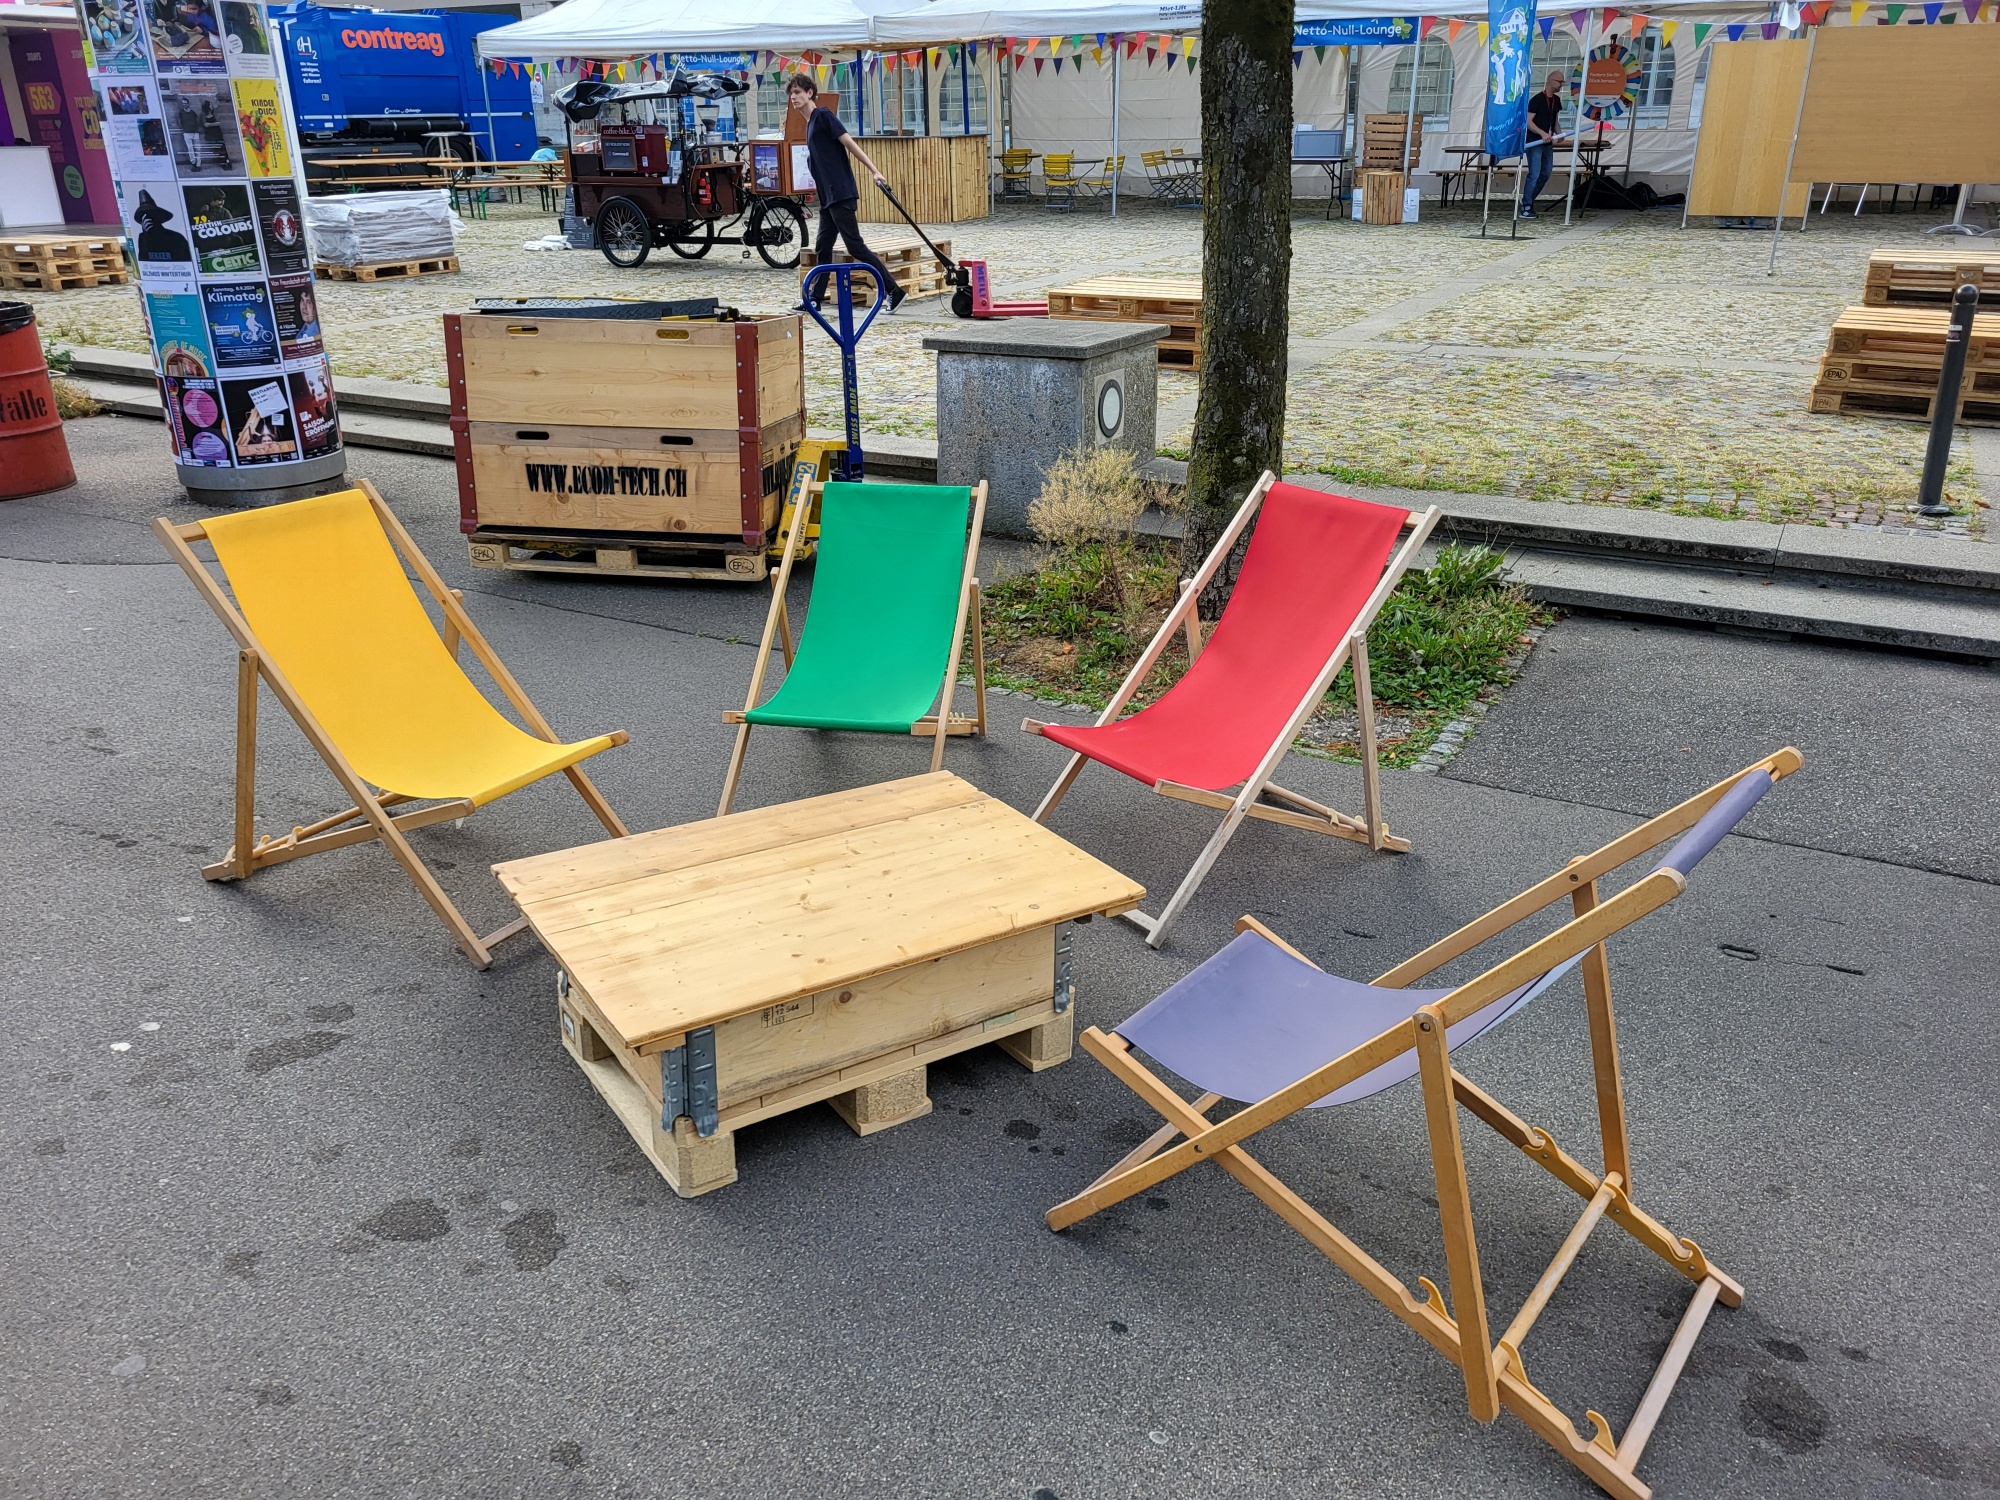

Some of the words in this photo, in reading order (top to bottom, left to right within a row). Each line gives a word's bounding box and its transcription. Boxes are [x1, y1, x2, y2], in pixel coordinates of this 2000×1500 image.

[1294, 25, 1402, 38] Netto-Null-Lounge
[341, 27, 445, 57] contreag
[674, 54, 745, 65] Netto-Null-Lounge
[29, 86, 55, 111] 563
[603, 127, 629, 135] coffee-bike
[191, 221, 222, 231] SCOTTISH
[198, 220, 253, 239] COLOURS
[212, 252, 255, 272] CELTIC
[977, 265, 986, 298] MEILI
[207, 292, 263, 303] Klimatag
[188, 345, 207, 361] MUSIC
[849, 387, 858, 415] MADE
[303, 417, 325, 430] SAISON
[851, 417, 859, 446] SWISS
[525, 464, 688, 498] WWW.ECOM-TECH.CH
